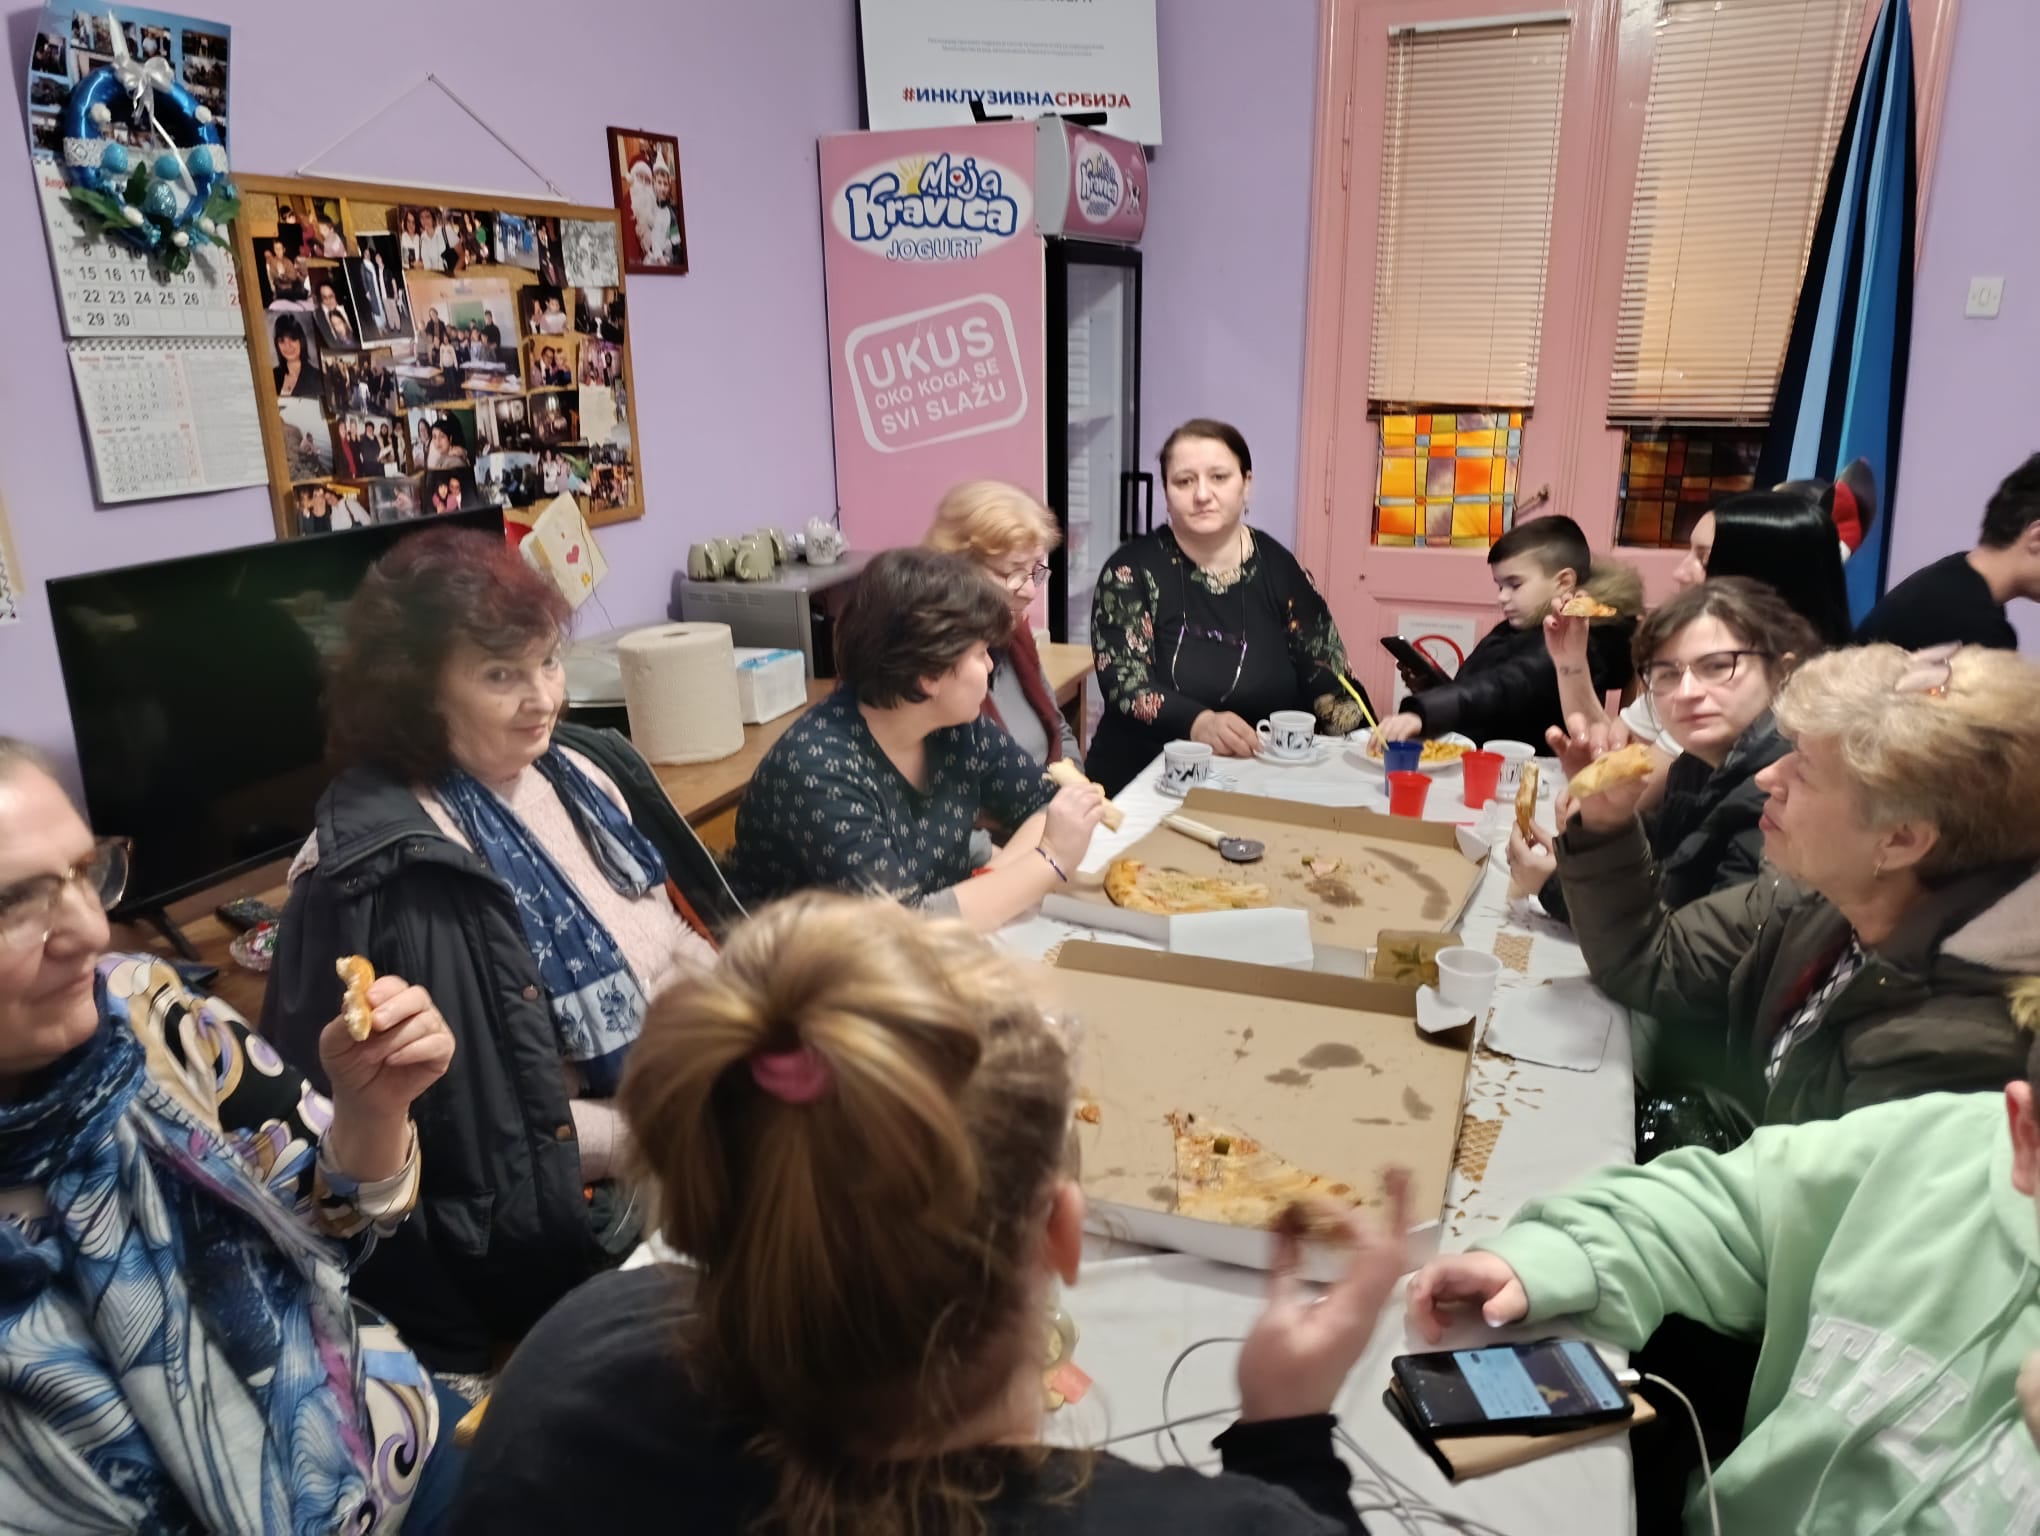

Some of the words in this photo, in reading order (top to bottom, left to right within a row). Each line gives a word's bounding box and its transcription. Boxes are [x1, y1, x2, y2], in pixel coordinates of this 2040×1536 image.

[902, 87, 1131, 108] #ИНКЛУЗИВНАСРБИЈА
[918, 153, 1002, 199] Moja
[846, 173, 1018, 241] Kravica
[82, 242, 92, 257] 8
[107, 244, 117, 259] 9
[886, 237, 982, 261] JOGURT
[79, 266, 97, 280] 15
[104, 268, 121, 281] 16
[130, 268, 146, 282] 17
[155, 270, 171, 284] 18
[182, 271, 196, 284] 19
[83, 289, 101, 303] 22
[108, 290, 126, 304] 23
[134, 291, 152, 304] 24
[159, 292, 176, 305] 25
[183, 292, 200, 305] 26
[87, 312, 105, 327] 29
[113, 313, 130, 327] 30
[863, 317, 995, 388] UKUS
[875, 385, 913, 409] OKO
[918, 368, 970, 396] KOGA
[974, 357, 1000, 378] SE
[881, 406, 920, 435] SVI
[926, 379, 1006, 421] SLAŽU
